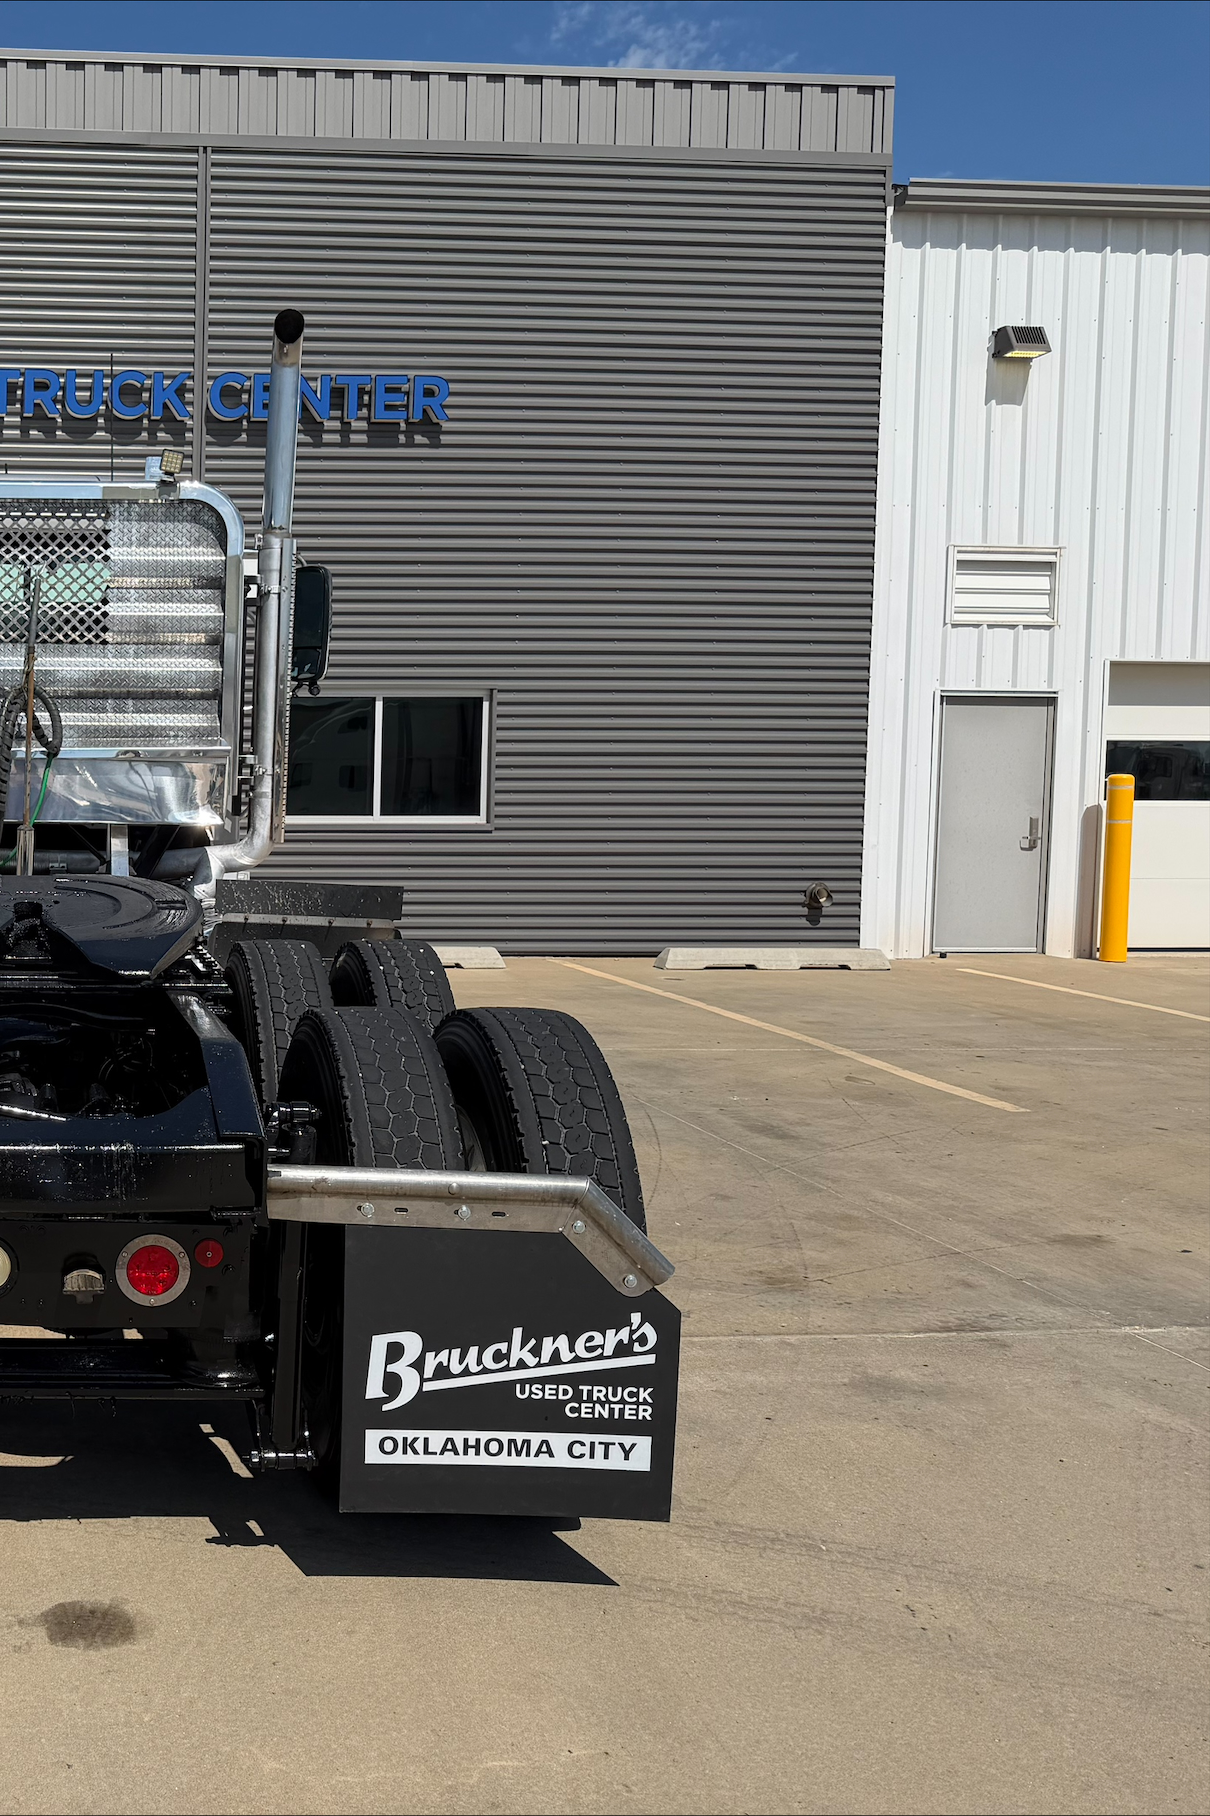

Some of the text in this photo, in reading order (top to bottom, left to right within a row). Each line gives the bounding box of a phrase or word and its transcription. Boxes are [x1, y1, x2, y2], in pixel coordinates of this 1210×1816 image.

[364, 1311, 659, 1412] Bruckner's
[515, 1383, 655, 1403] USED TRUCK
[564, 1402, 653, 1421] CENTER
[377, 1435, 638, 1462] OKLAHOMA CITY
